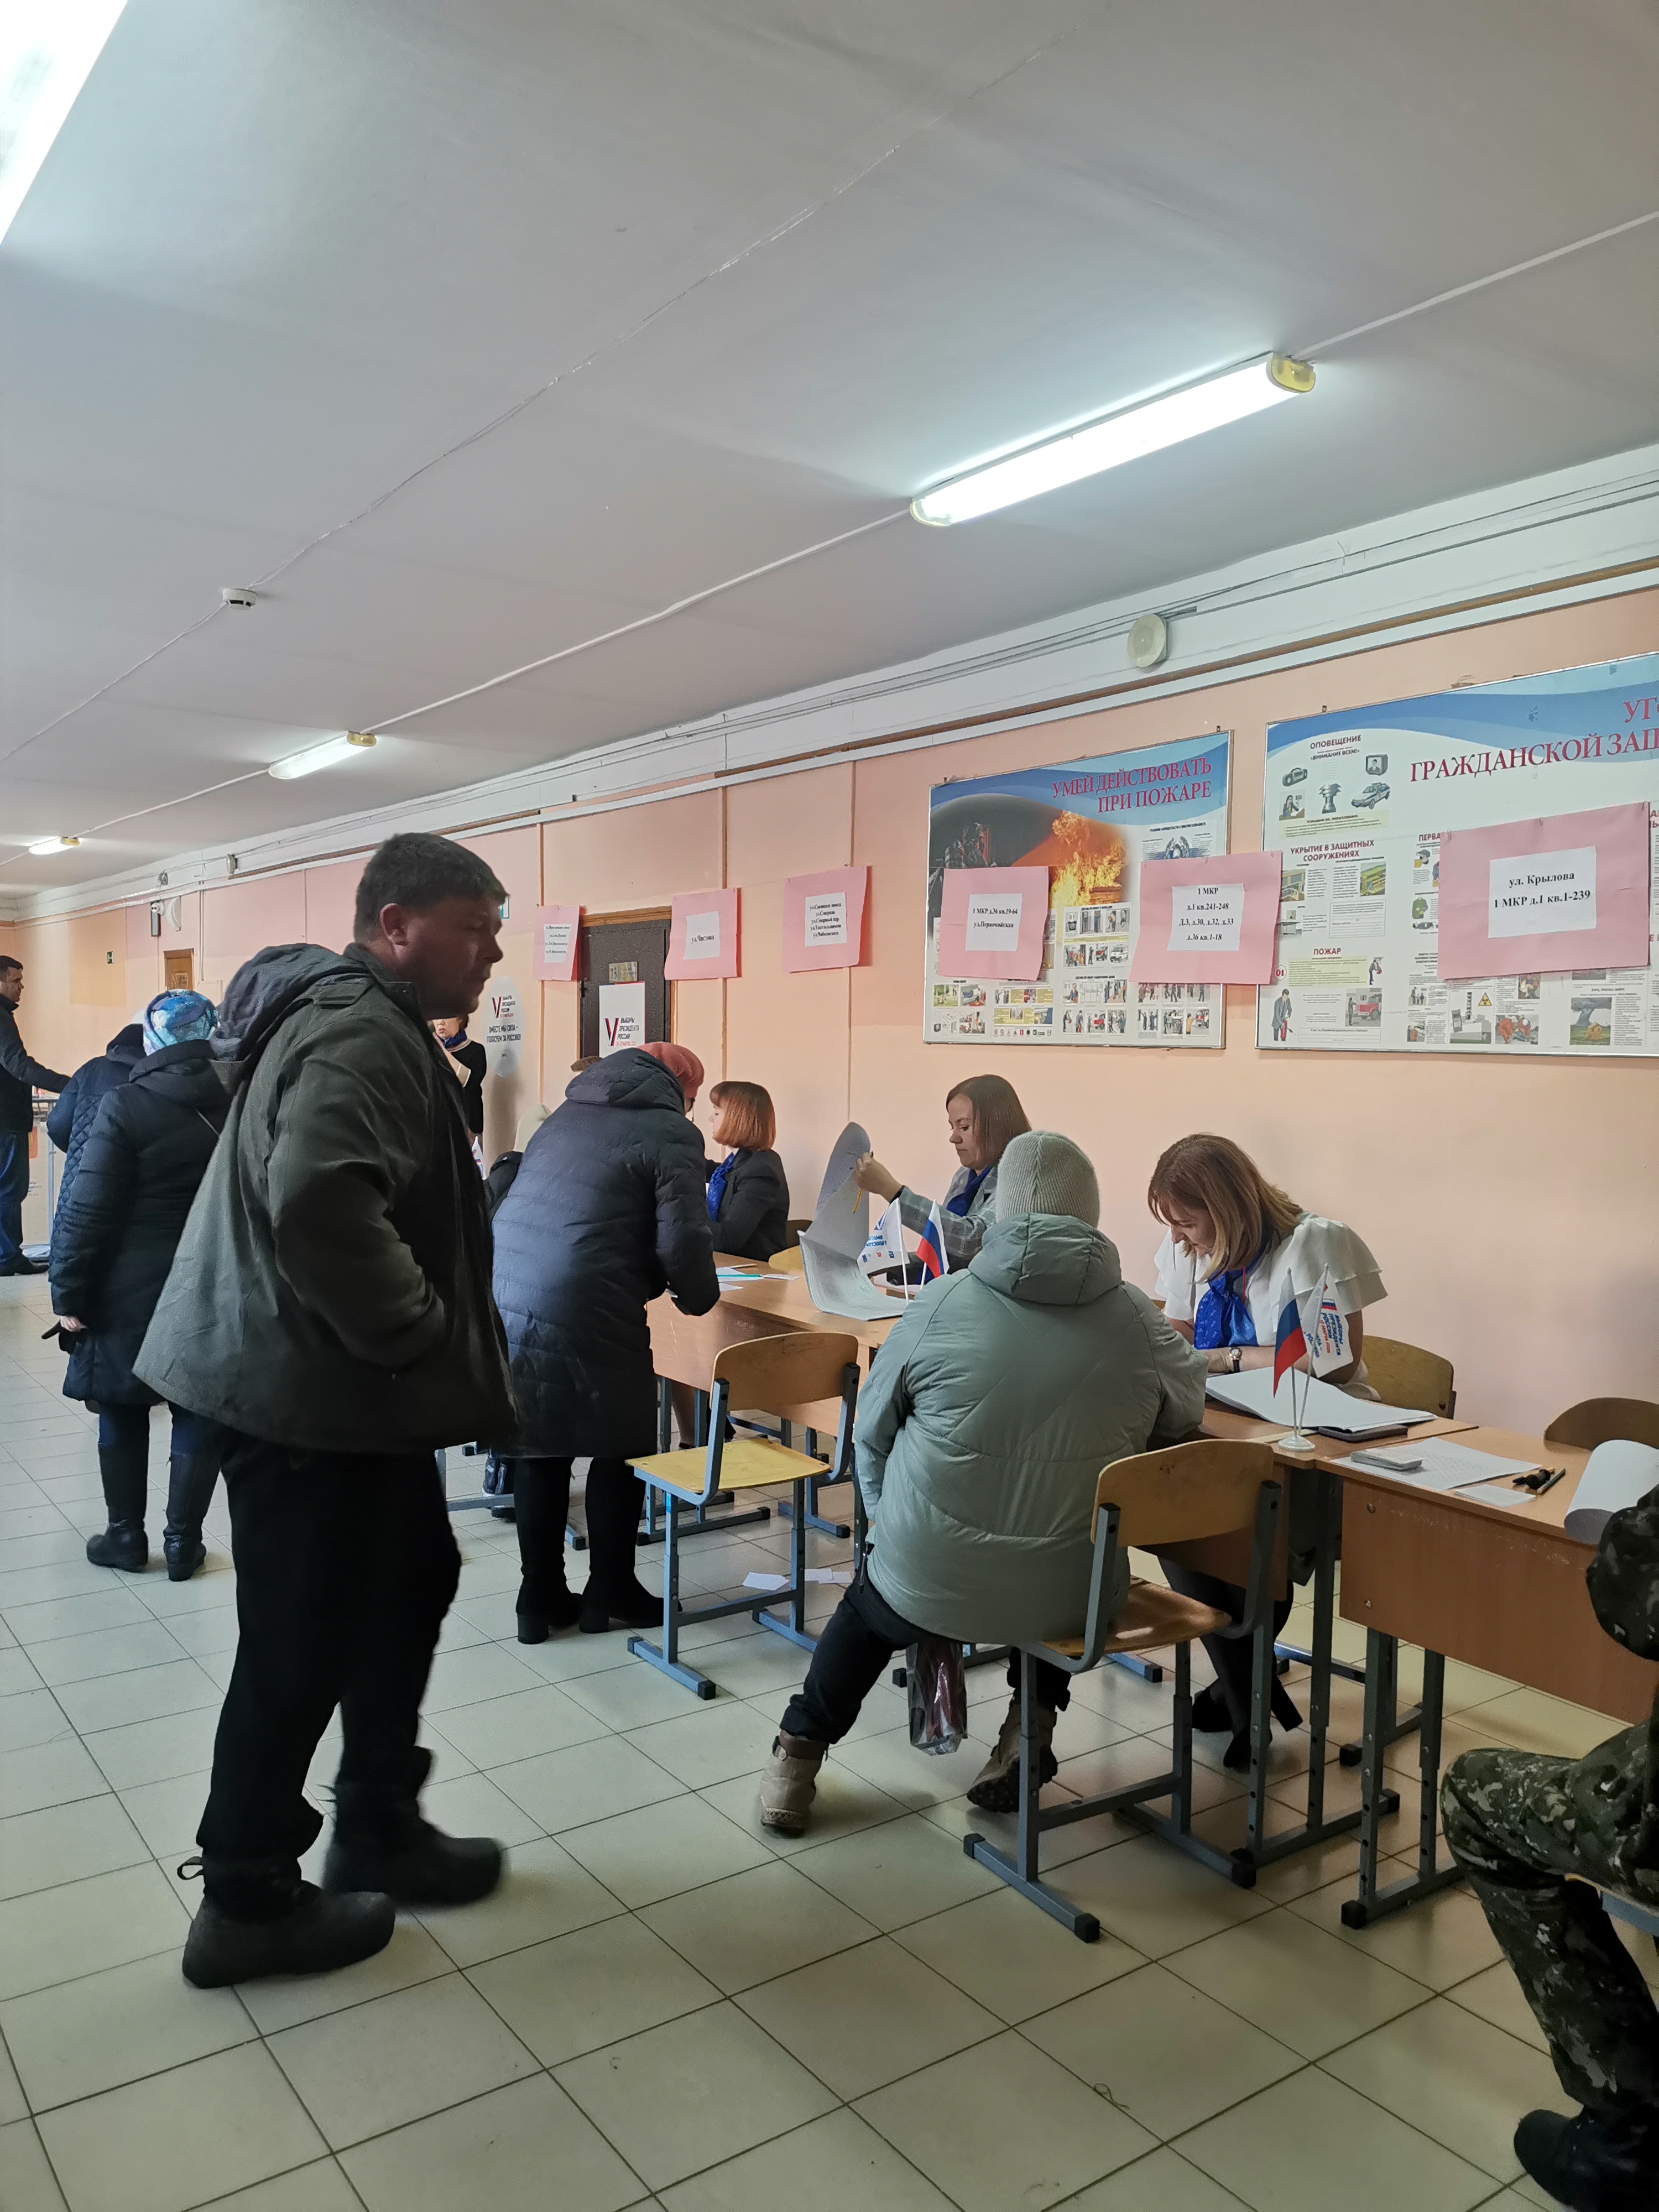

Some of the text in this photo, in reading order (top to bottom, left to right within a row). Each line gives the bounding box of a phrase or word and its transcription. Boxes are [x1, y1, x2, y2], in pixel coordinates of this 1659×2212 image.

[1623, 697, 1659, 723] УГ
[1310, 734, 1361, 749] ОПОВЕЩЕНИЕ
[1410, 732, 1603, 782] ГРАЖДАНСКОЙ
[1052, 757, 1211, 798] УМЕЙ ДЕЙСТВОВАТЬ
[1098, 781, 1211, 813] ПРИ ПОЖАРЕ
[1291, 845, 1322, 854] УКРЫТИЕ
[1331, 839, 1374, 851] ЗАЩИТНЫХ
[1303, 850, 1359, 862] СООРУЖЕНИЯХ
[1509, 872, 1575, 888] ул. Крылова
[1197, 902, 1229, 910] кв.241-248
[1494, 890, 1590, 907] 1 МКР д.1 кв.1-239
[1334, 1314, 1343, 1344] ВЫБОРЫ
